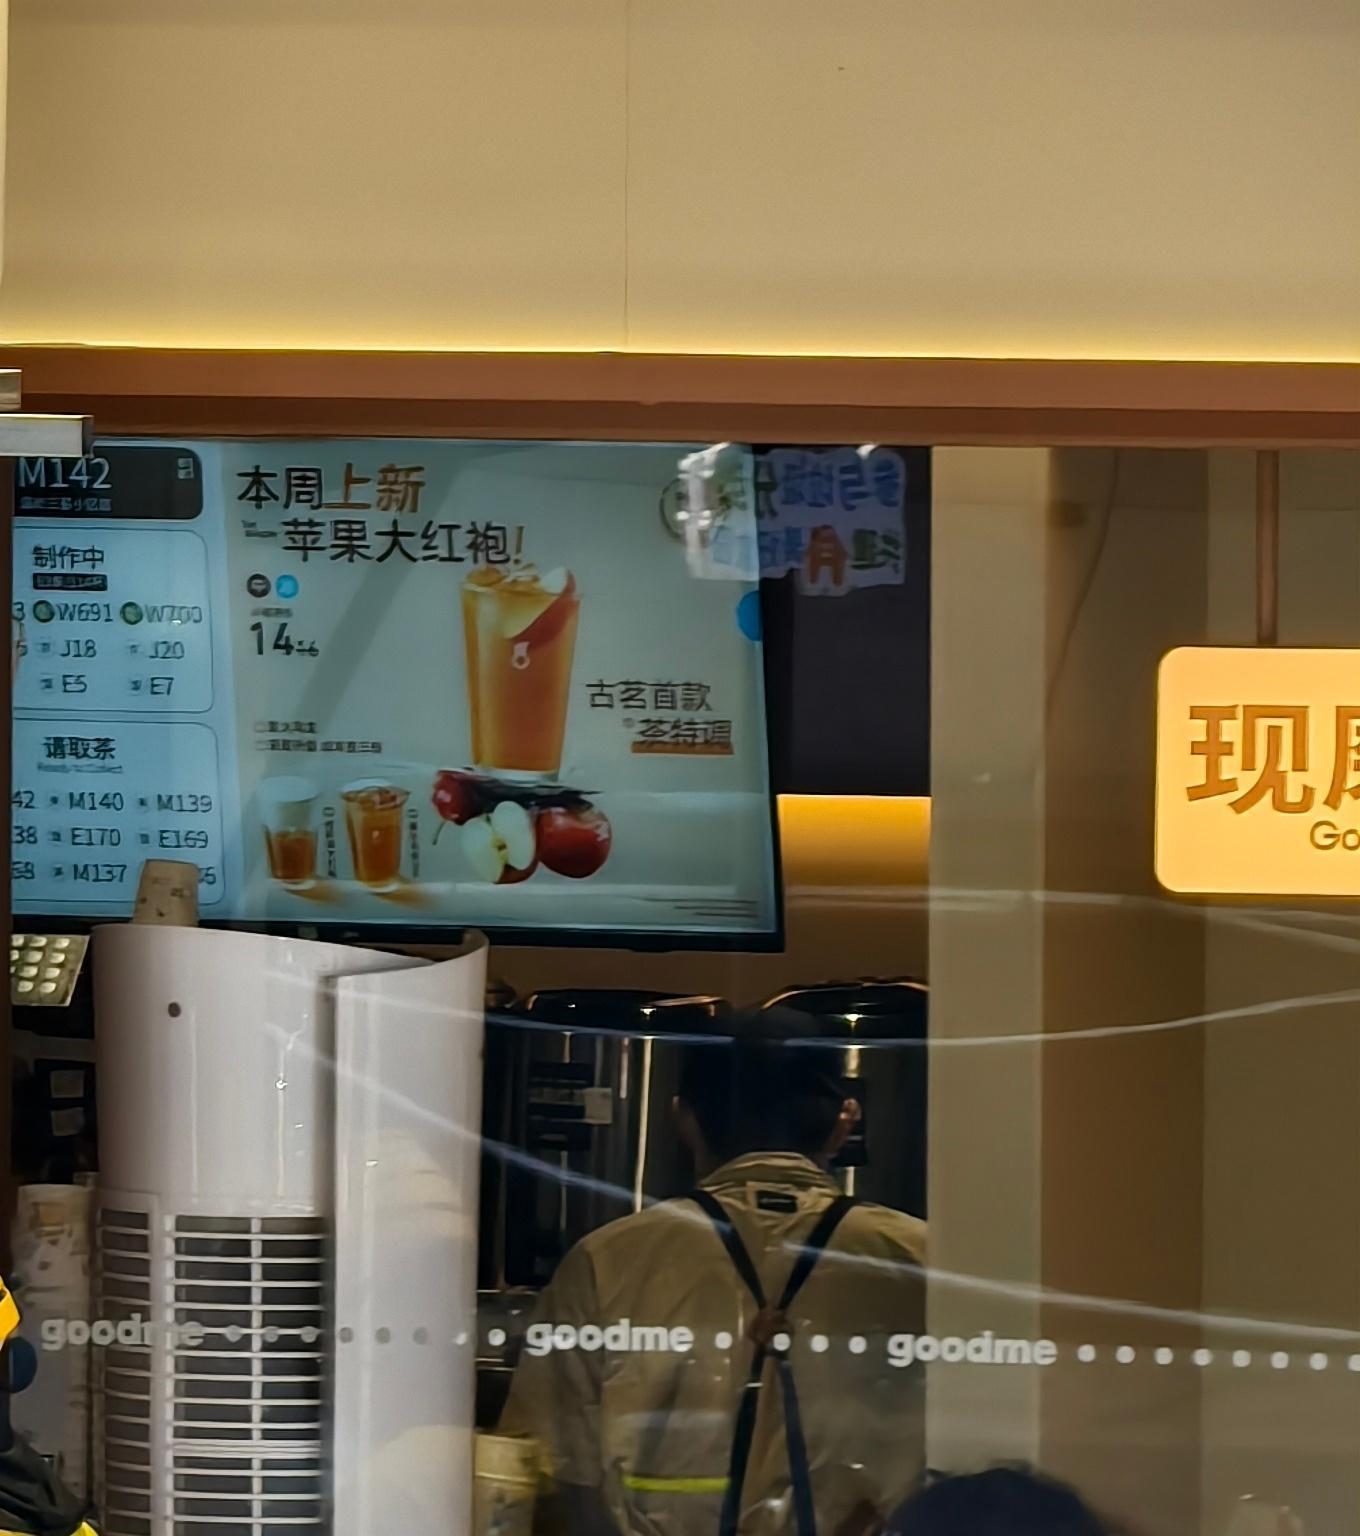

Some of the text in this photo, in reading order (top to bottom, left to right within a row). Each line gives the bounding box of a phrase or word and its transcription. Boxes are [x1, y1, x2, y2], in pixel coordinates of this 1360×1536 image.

[18, 457, 113, 489] M142
[236, 462, 427, 513] 本周上新
[281, 518, 525, 565] 苹果大红袍!
[32, 544, 105, 570] 制作中
[249, 621, 295, 656] 14
[150, 676, 174, 696] E7
[586, 679, 713, 712] 古茗首款
[43, 736, 116, 760] 请取茶
[69, 791, 125, 811] M140
[71, 827, 121, 846] E170
[73, 863, 127, 883] M137
[526, 1318, 695, 1355] goodme
[887, 1331, 1057, 1368] goodme
